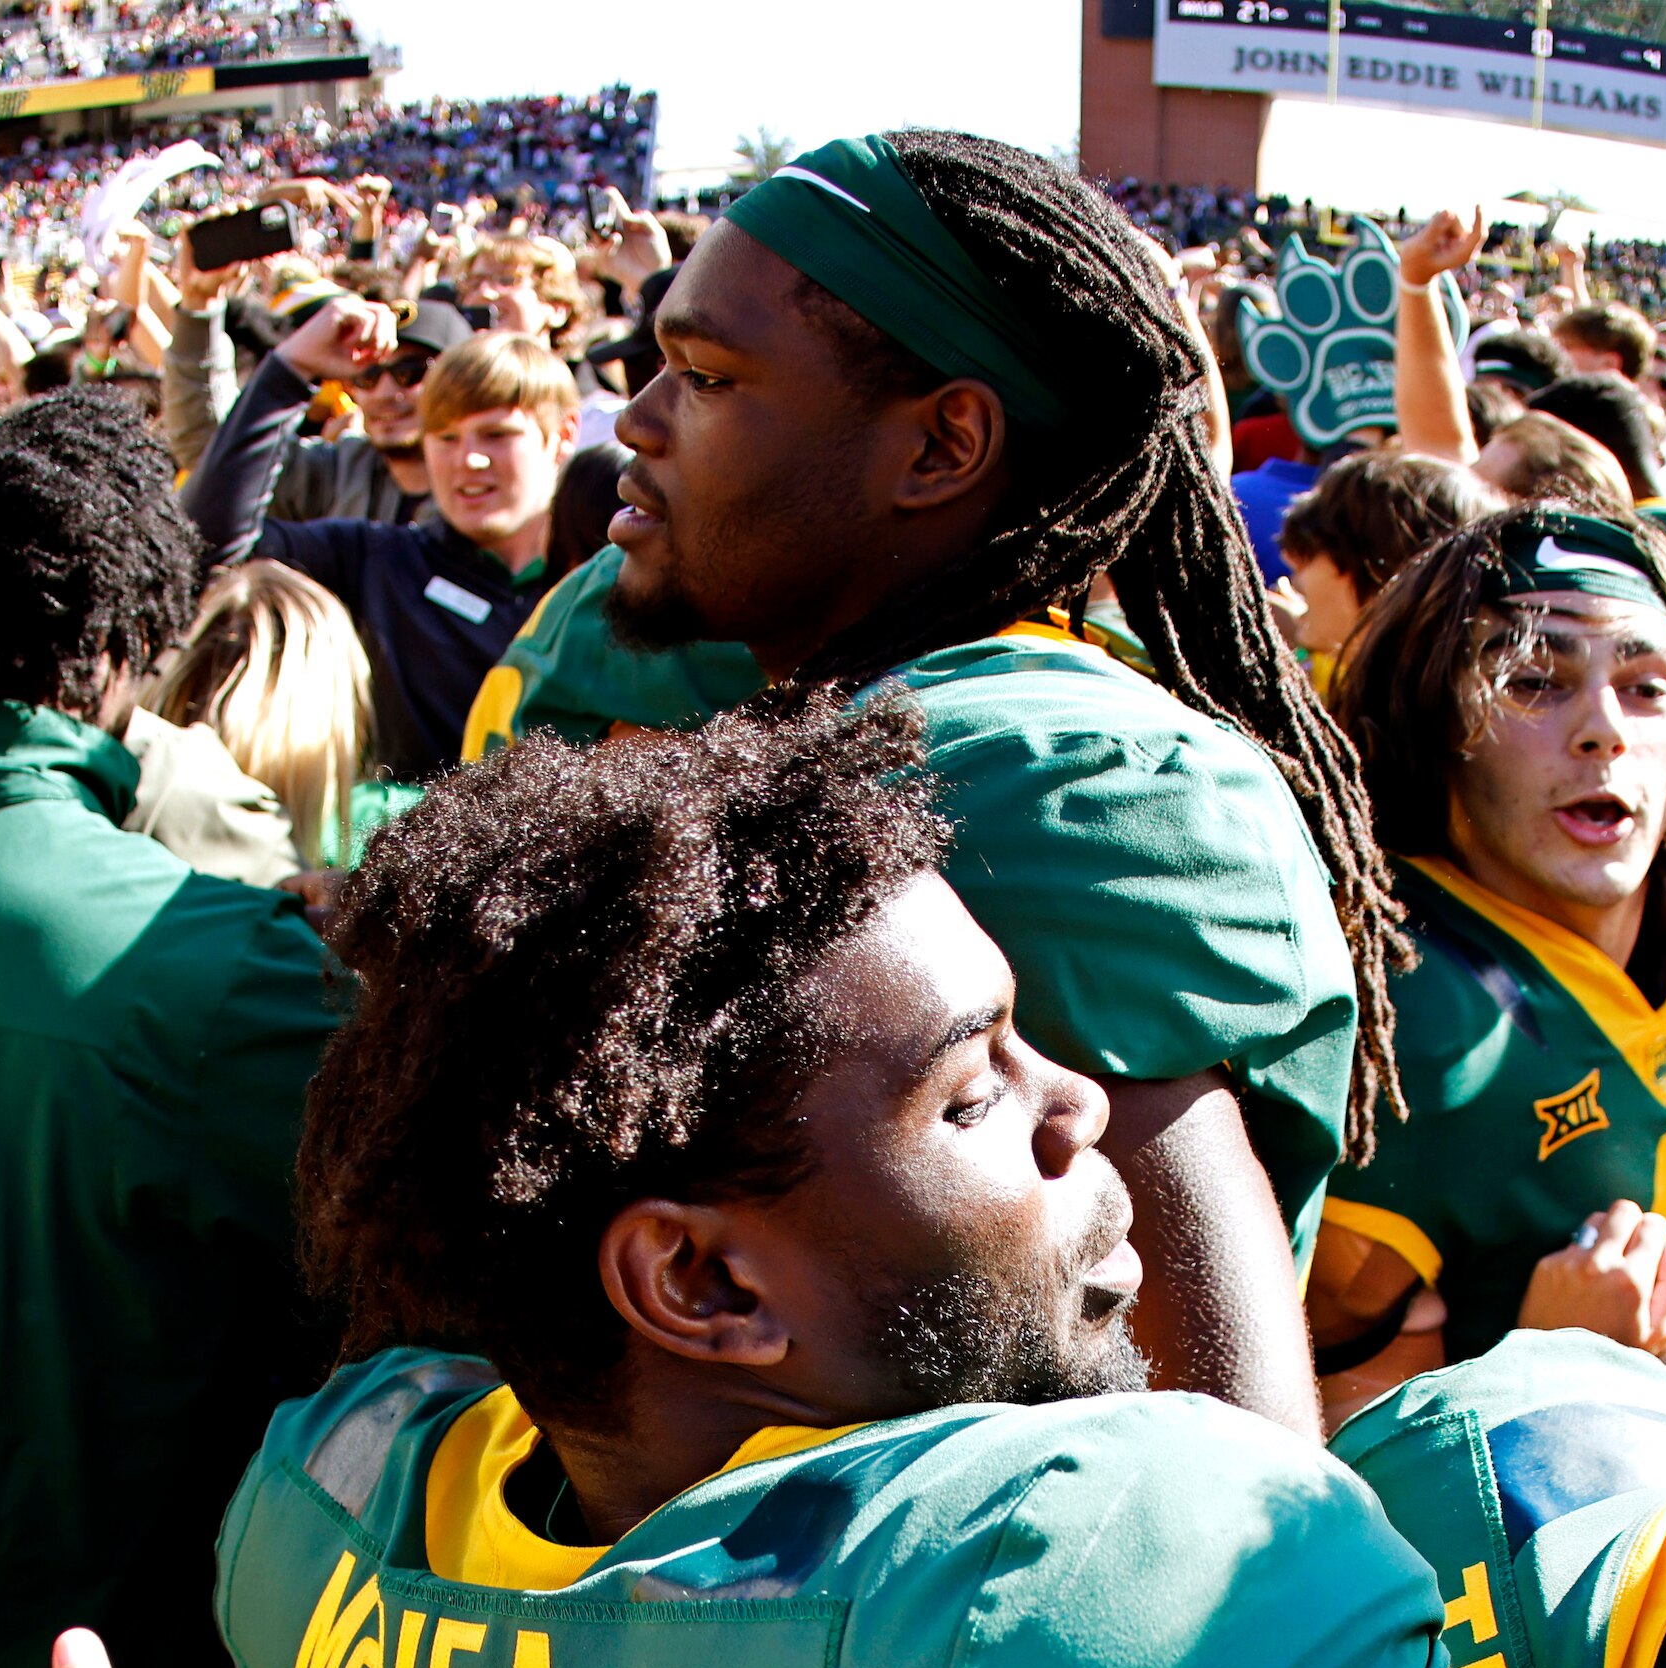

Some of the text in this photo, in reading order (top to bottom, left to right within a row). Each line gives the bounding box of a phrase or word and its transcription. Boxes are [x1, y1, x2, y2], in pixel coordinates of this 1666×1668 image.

[1232, 46, 1329, 74] JOHN
[1347, 55, 1461, 90] EDDIE
[1477, 69, 1663, 120] WILLIAMS
